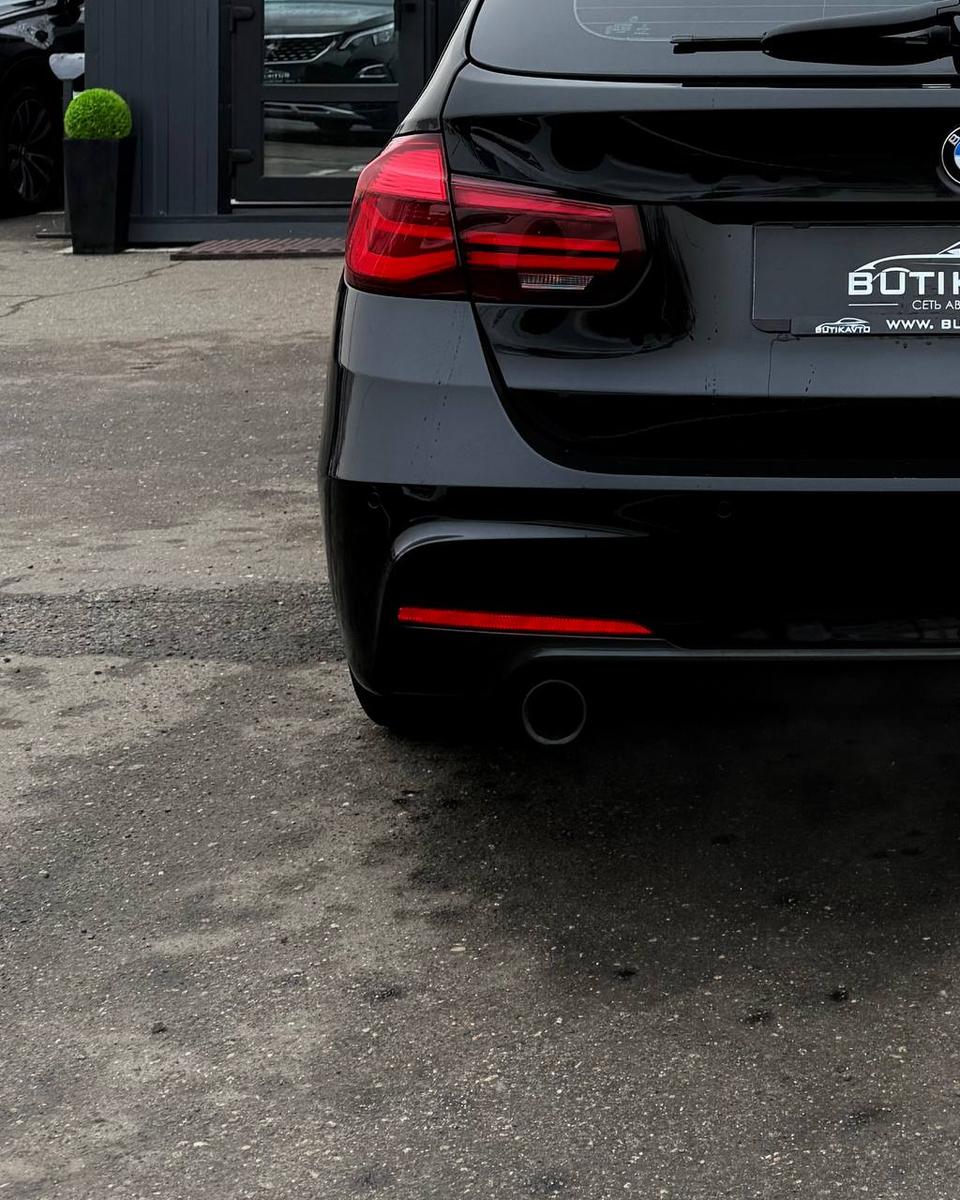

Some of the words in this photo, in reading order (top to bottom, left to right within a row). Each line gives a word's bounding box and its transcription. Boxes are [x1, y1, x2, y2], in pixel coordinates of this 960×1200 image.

[911, 300, 942, 310] СЕТЬ
[886, 319, 934, 330] WWW.
[815, 326, 871, 334] BUTIKAVTO
